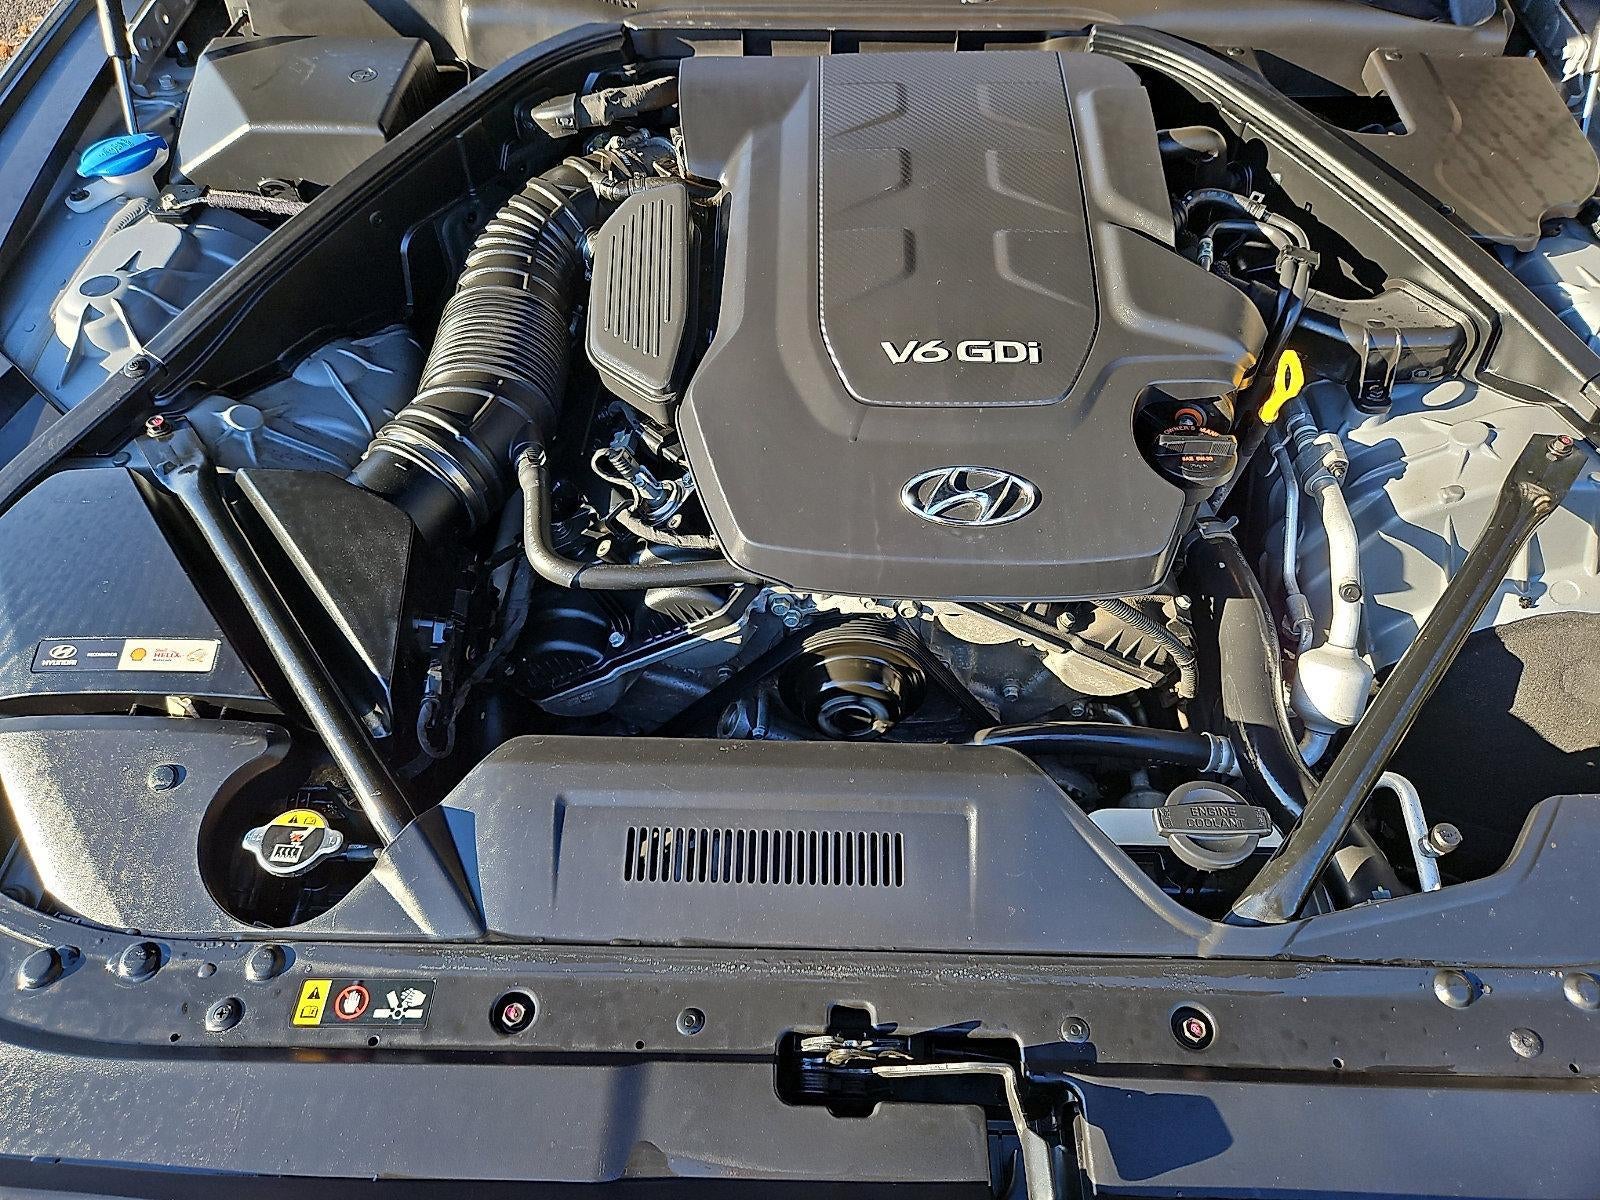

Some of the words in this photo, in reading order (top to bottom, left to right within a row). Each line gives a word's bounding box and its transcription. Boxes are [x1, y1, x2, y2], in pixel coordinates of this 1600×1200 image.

[880, 340, 951, 364] V6
[956, 340, 1041, 364] GDi
[1189, 806, 1237, 817] ENGINE
[1186, 817, 1245, 828] COOLANT
